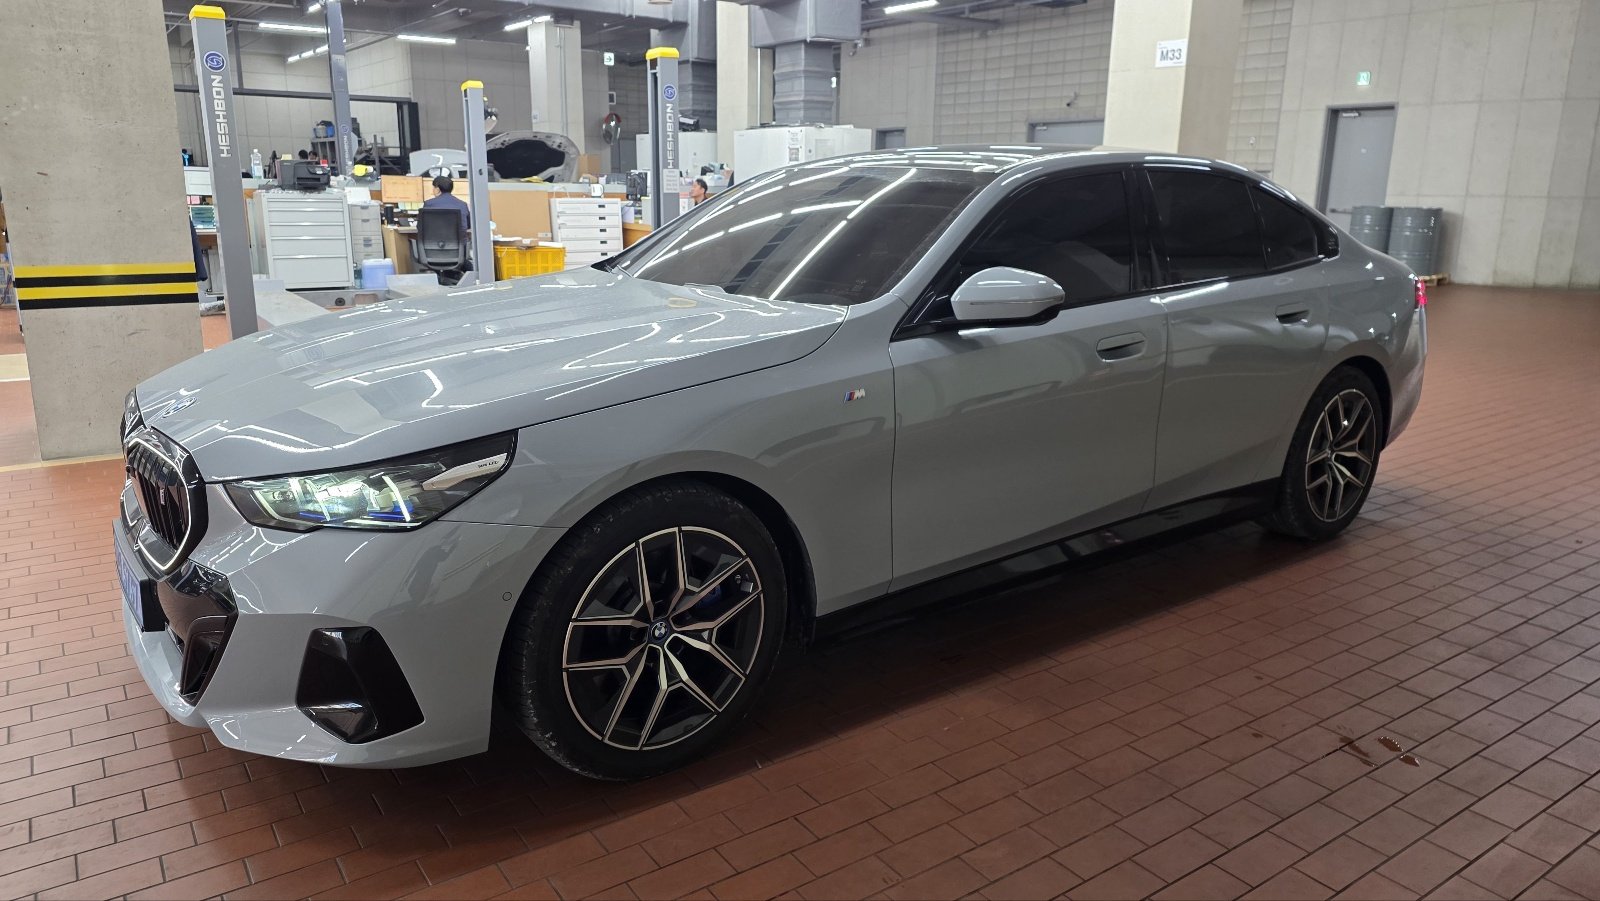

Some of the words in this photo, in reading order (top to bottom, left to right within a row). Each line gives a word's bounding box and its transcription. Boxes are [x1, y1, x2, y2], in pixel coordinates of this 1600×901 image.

[1160, 48, 1182, 61] M33
[210, 74, 232, 158] HESHBON
[666, 103, 675, 169] HESHBON
